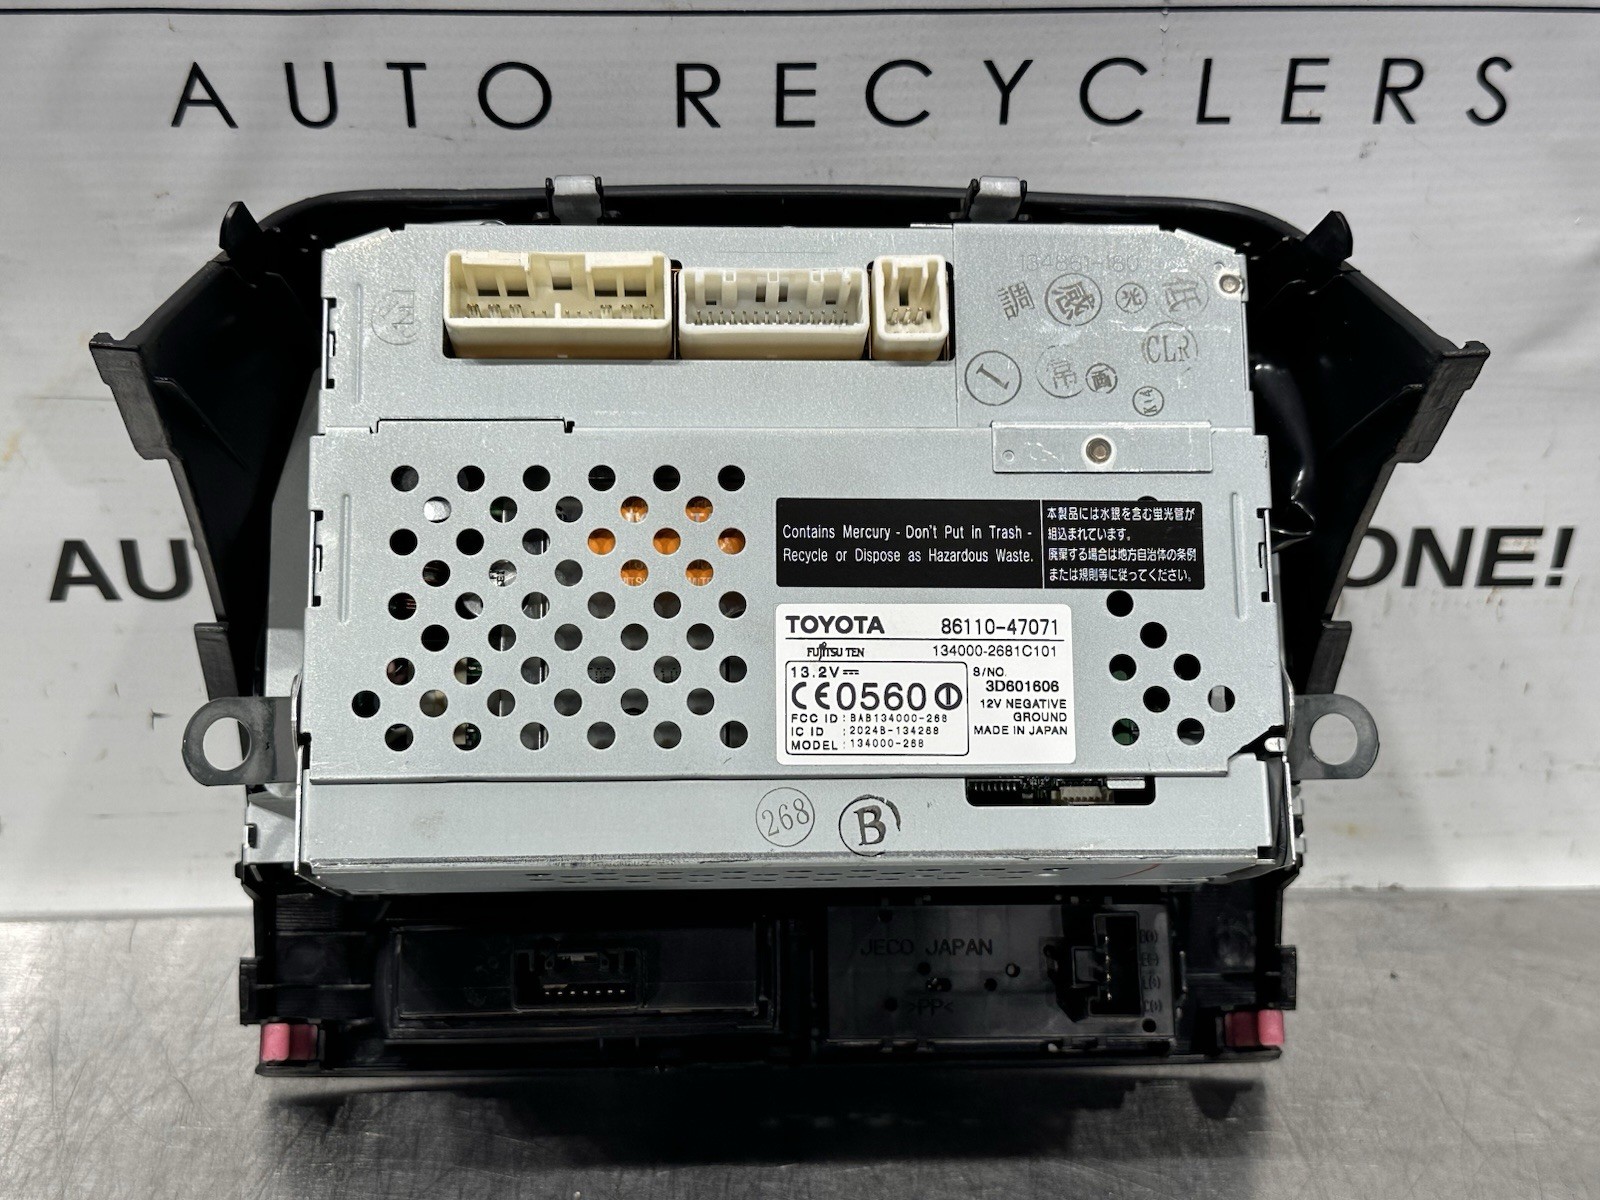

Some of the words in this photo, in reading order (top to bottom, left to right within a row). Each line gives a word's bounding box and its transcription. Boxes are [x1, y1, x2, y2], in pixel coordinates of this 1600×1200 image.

[171, 60, 553, 129] AUTO
[677, 56, 1513, 128] RECYCLERS
[1145, 334, 1190, 364] CLR
[783, 524, 835, 538] Contains
[843, 524, 890, 541] Mercury
[906, 524, 937, 539] Don't
[945, 525, 964, 539] Put
[989, 525, 1022, 539] Trash
[1047, 527, 1131, 541] 組込まれています。
[783, 548, 828, 564] Recycle
[836, 551, 847, 562] or
[855, 548, 901, 564] Dispose
[908, 551, 921, 562] as
[929, 548, 988, 562] Hazardous
[996, 548, 1034, 562] Waste.
[785, 616, 885, 634] TOYOTA
[941, 618, 1057, 635] 86110-47071
[807, 642, 842, 660] FUJITSU
[845, 648, 864, 658] TEN
[933, 645, 1056, 657] 134000-2681C101
[791, 667, 839, 678] 13.2V
[986, 680, 1059, 692] 3D601606
[981, 699, 1001, 708] 12V
[1006, 699, 1067, 709] NEGATIVE
[791, 714, 818, 723] FCC
[825, 714, 838, 723] ID
[1013, 712, 1067, 722] GROUND
[791, 727, 804, 736] IC
[811, 727, 824, 736] ID
[974, 726, 1008, 735] MADE
[1014, 726, 1024, 735] IN
[1029, 726, 1068, 735] JAPAN
[791, 741, 838, 750] MODEL
[761, 797, 810, 837] 268
[852, 804, 887, 846] B
[861, 938, 915, 956] JECO
[925, 938, 993, 956] JAPAN
